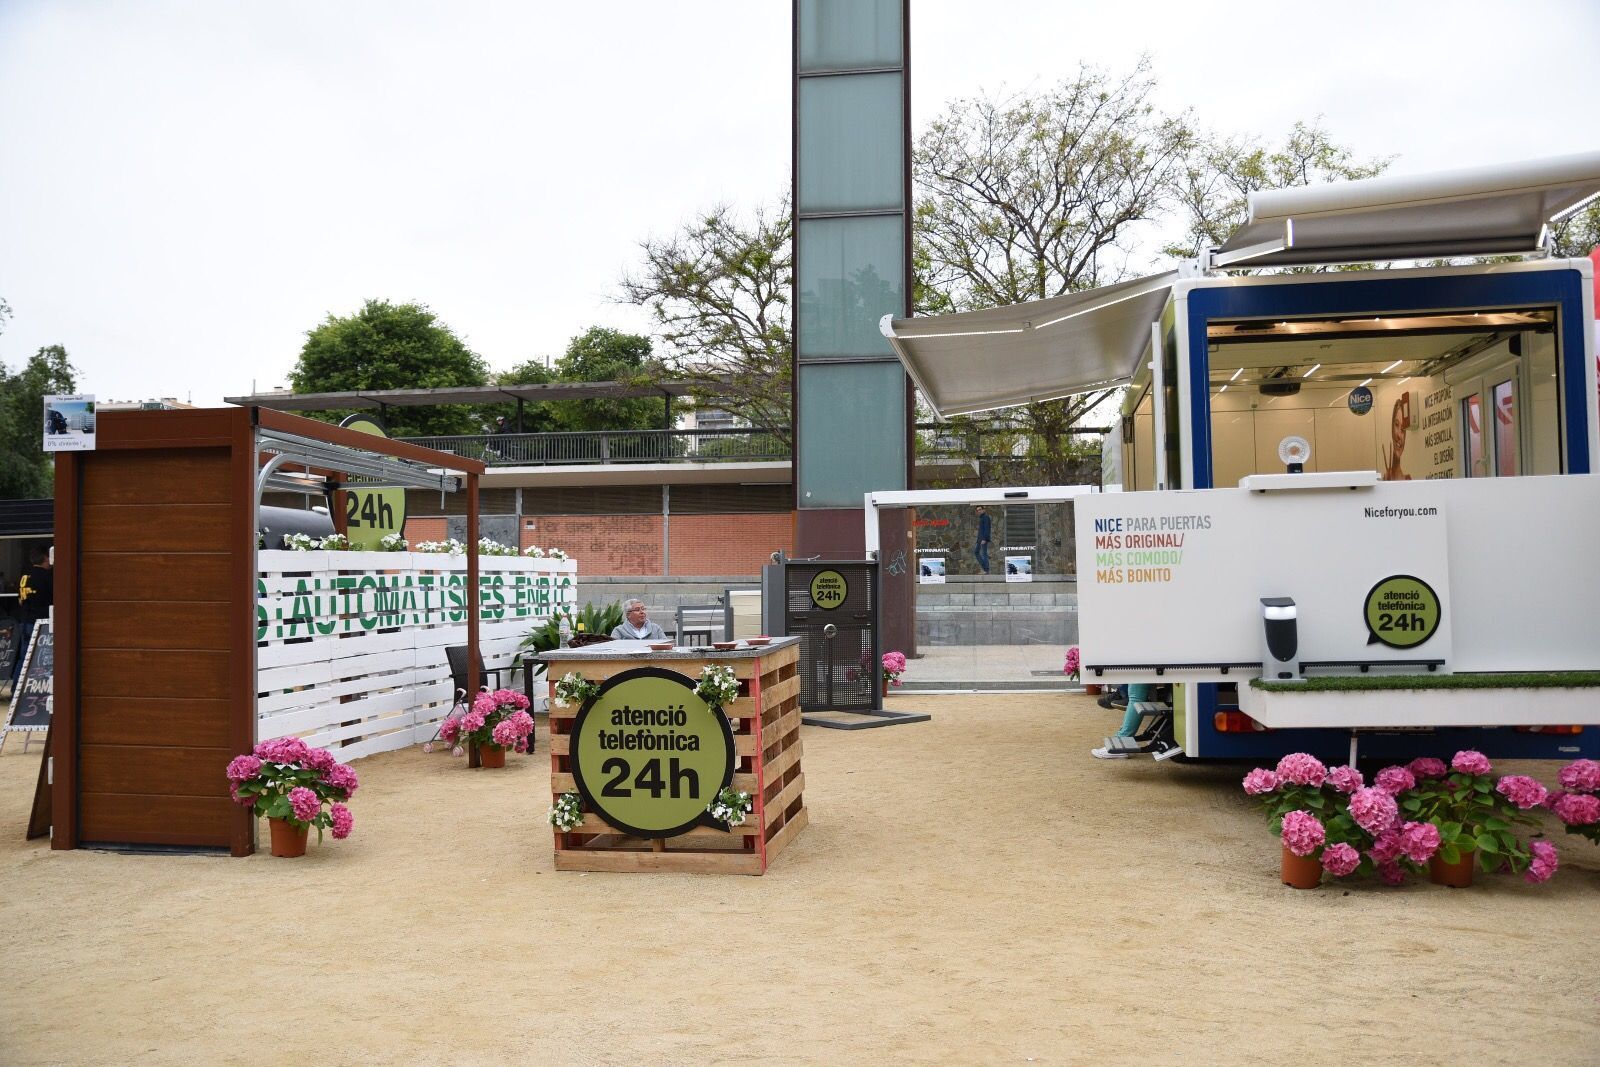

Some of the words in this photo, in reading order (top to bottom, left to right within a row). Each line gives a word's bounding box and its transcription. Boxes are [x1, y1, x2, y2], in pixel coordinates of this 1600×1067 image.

[1350, 394, 1371, 404] Nice
[1424, 396, 1433, 409] NICE
[1439, 446, 1454, 464] DISEÑO
[347, 490, 394, 530] 24h
[1364, 506, 1437, 519] Niceforyou.com
[1095, 518, 1122, 532] NICE
[1126, 517, 1157, 531] PARA
[1160, 515, 1212, 531] PUERTAS
[1095, 533, 1121, 549] MÁS
[1125, 533, 1185, 549] ORIGINAL/
[1096, 550, 1122, 567] MÁS
[1096, 567, 1123, 584] MÁS
[1127, 568, 1171, 583] BONITO
[515, 576, 571, 617] ENRIC
[816, 590, 841, 601] 24h
[1383, 590, 1419, 600] atenció
[1378, 601, 1425, 611] telefònica
[1378, 613, 1425, 631] 24h
[610, 704, 687, 727] atenció
[598, 729, 700, 752] telefònica
[600, 757, 700, 799] 24h
